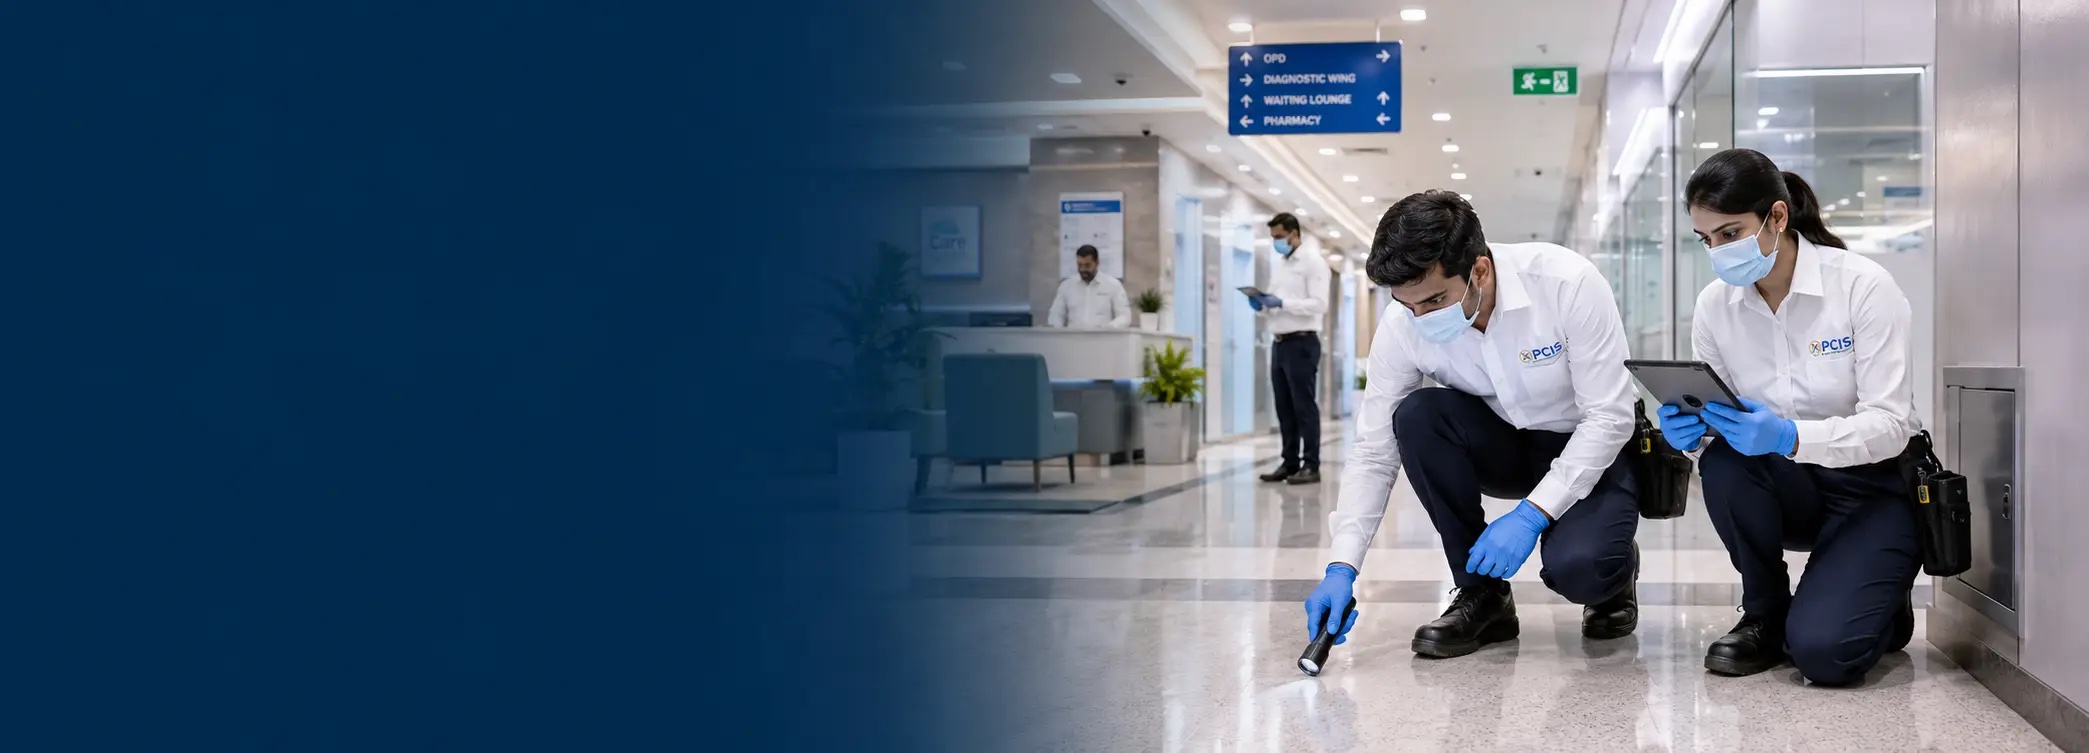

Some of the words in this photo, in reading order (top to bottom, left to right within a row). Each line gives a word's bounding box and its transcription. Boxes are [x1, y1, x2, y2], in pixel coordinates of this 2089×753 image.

[1263, 53, 1286, 64] OPD
[1263, 73, 1326, 85] DIAGNOSTIC
[1328, 72, 1356, 83] WING
[1263, 95, 1308, 106] WAITING
[1309, 94, 1352, 105] LOUNGE
[1263, 115, 1322, 126] PHARMACY
[930, 235, 966, 250] Care
[1532, 341, 1562, 360] PCIS
[1821, 336, 1852, 352] PCIS
